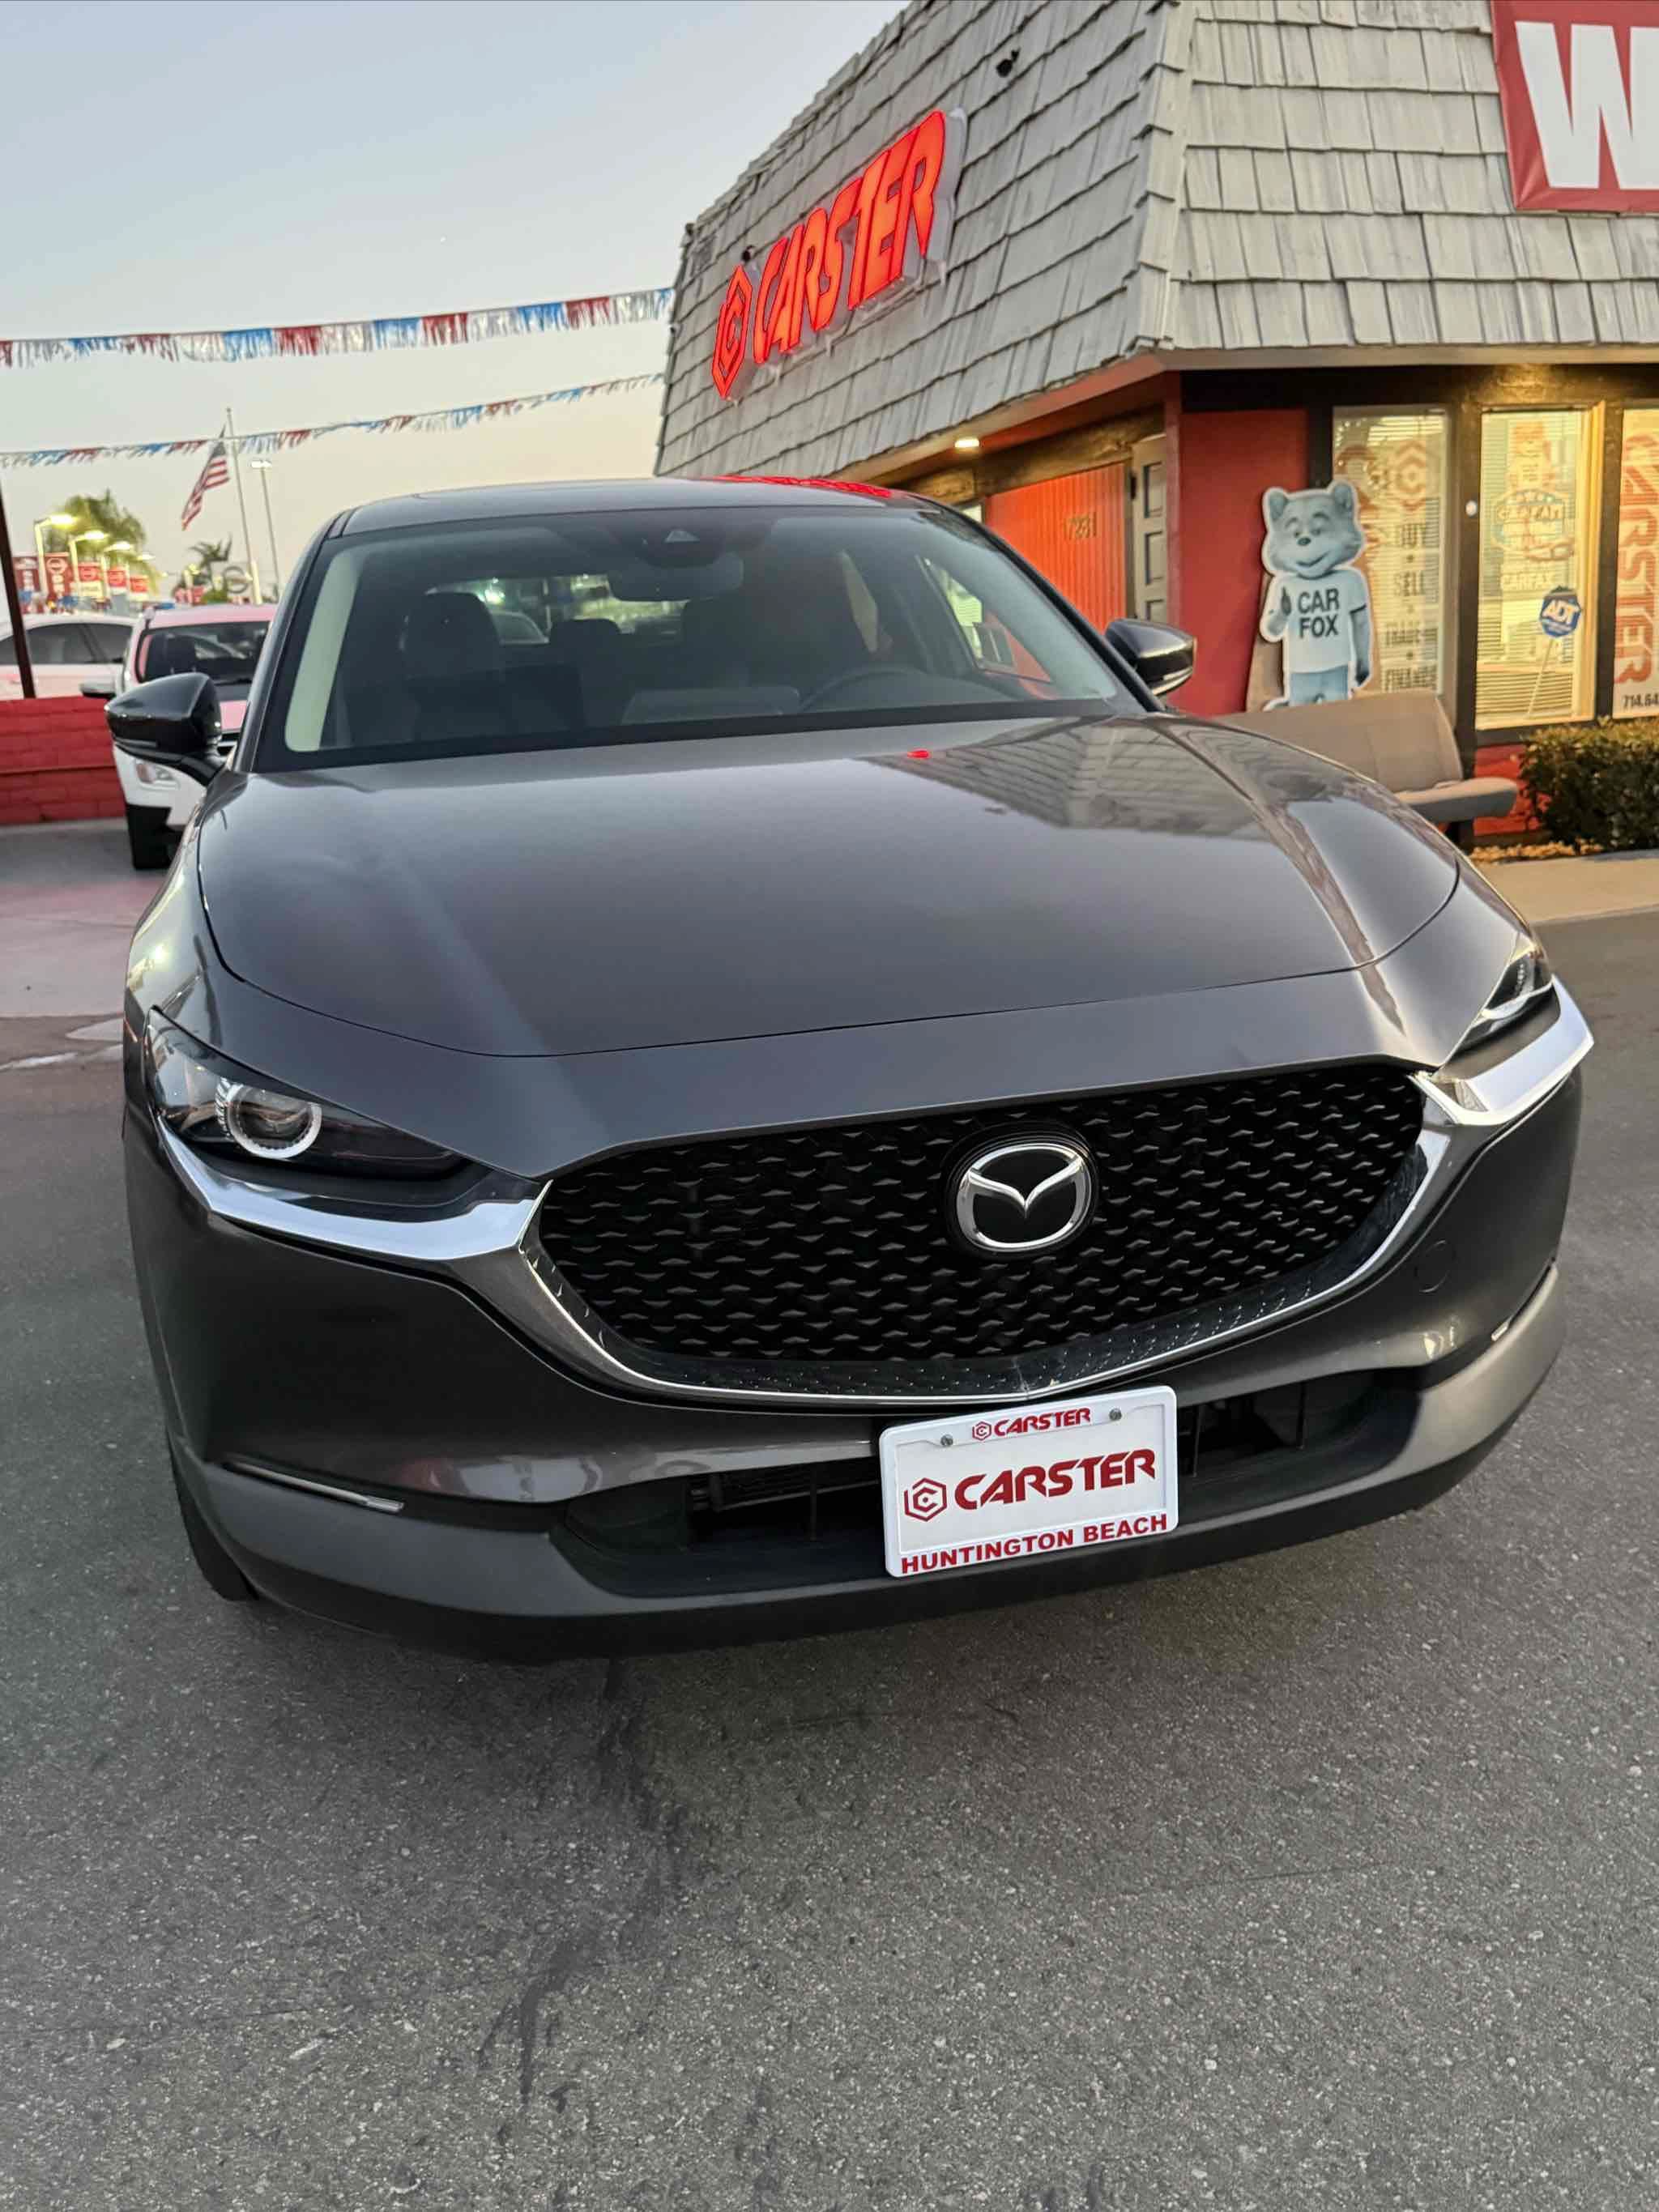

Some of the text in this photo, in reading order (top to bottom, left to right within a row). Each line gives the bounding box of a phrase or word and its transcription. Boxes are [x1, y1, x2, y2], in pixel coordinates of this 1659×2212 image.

[753, 109, 945, 364] CARSTER
[1298, 588, 1340, 614] CAR
[1299, 615, 1338, 639] FOX
[994, 1408, 1090, 1437] CARSTER
[954, 1448, 1155, 1511] CARSTER
[902, 1514, 1167, 1573] HUNTINGTON BEACH
